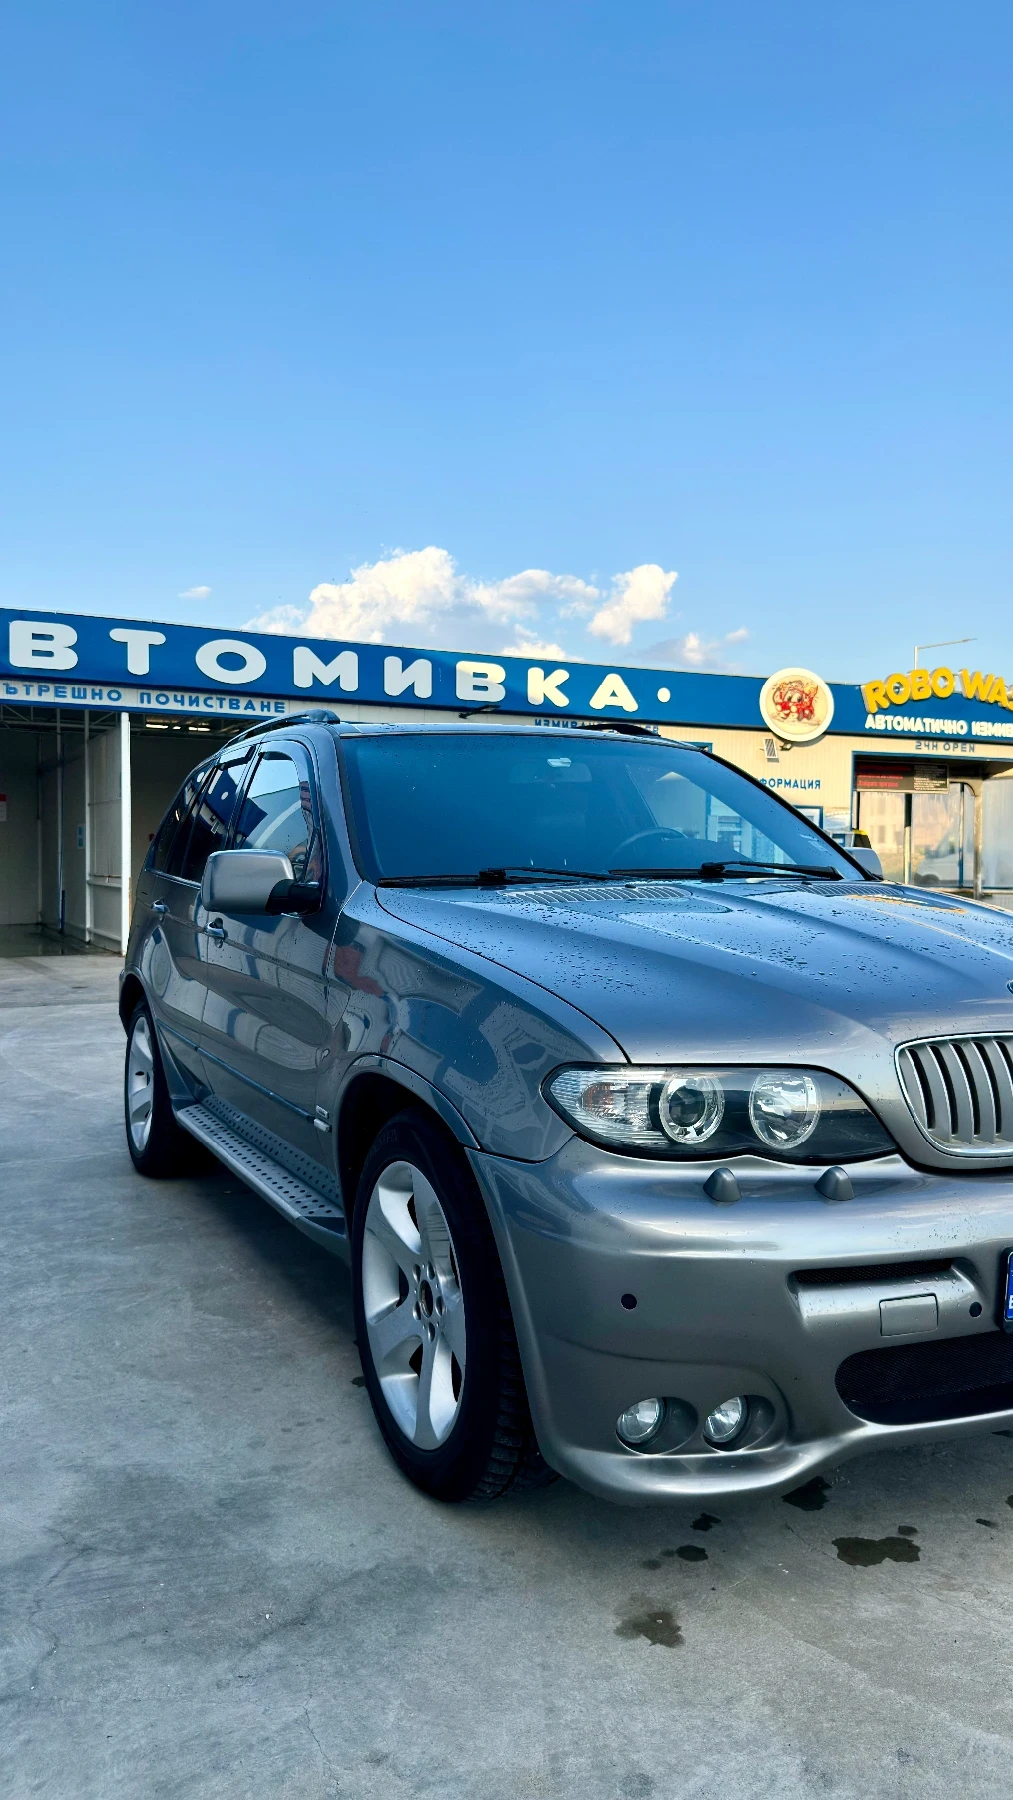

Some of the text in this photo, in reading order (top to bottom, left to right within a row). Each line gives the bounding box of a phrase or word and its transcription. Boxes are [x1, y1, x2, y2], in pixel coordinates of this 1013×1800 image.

[2, 682, 286, 714] ЪТРЕШНО ПОЧИСТВАНЕ
[861, 667, 956, 713] ROBO
[864, 713, 968, 735] АВТОМАТИЧНО
[915, 740, 975, 753] 24H OPEN
